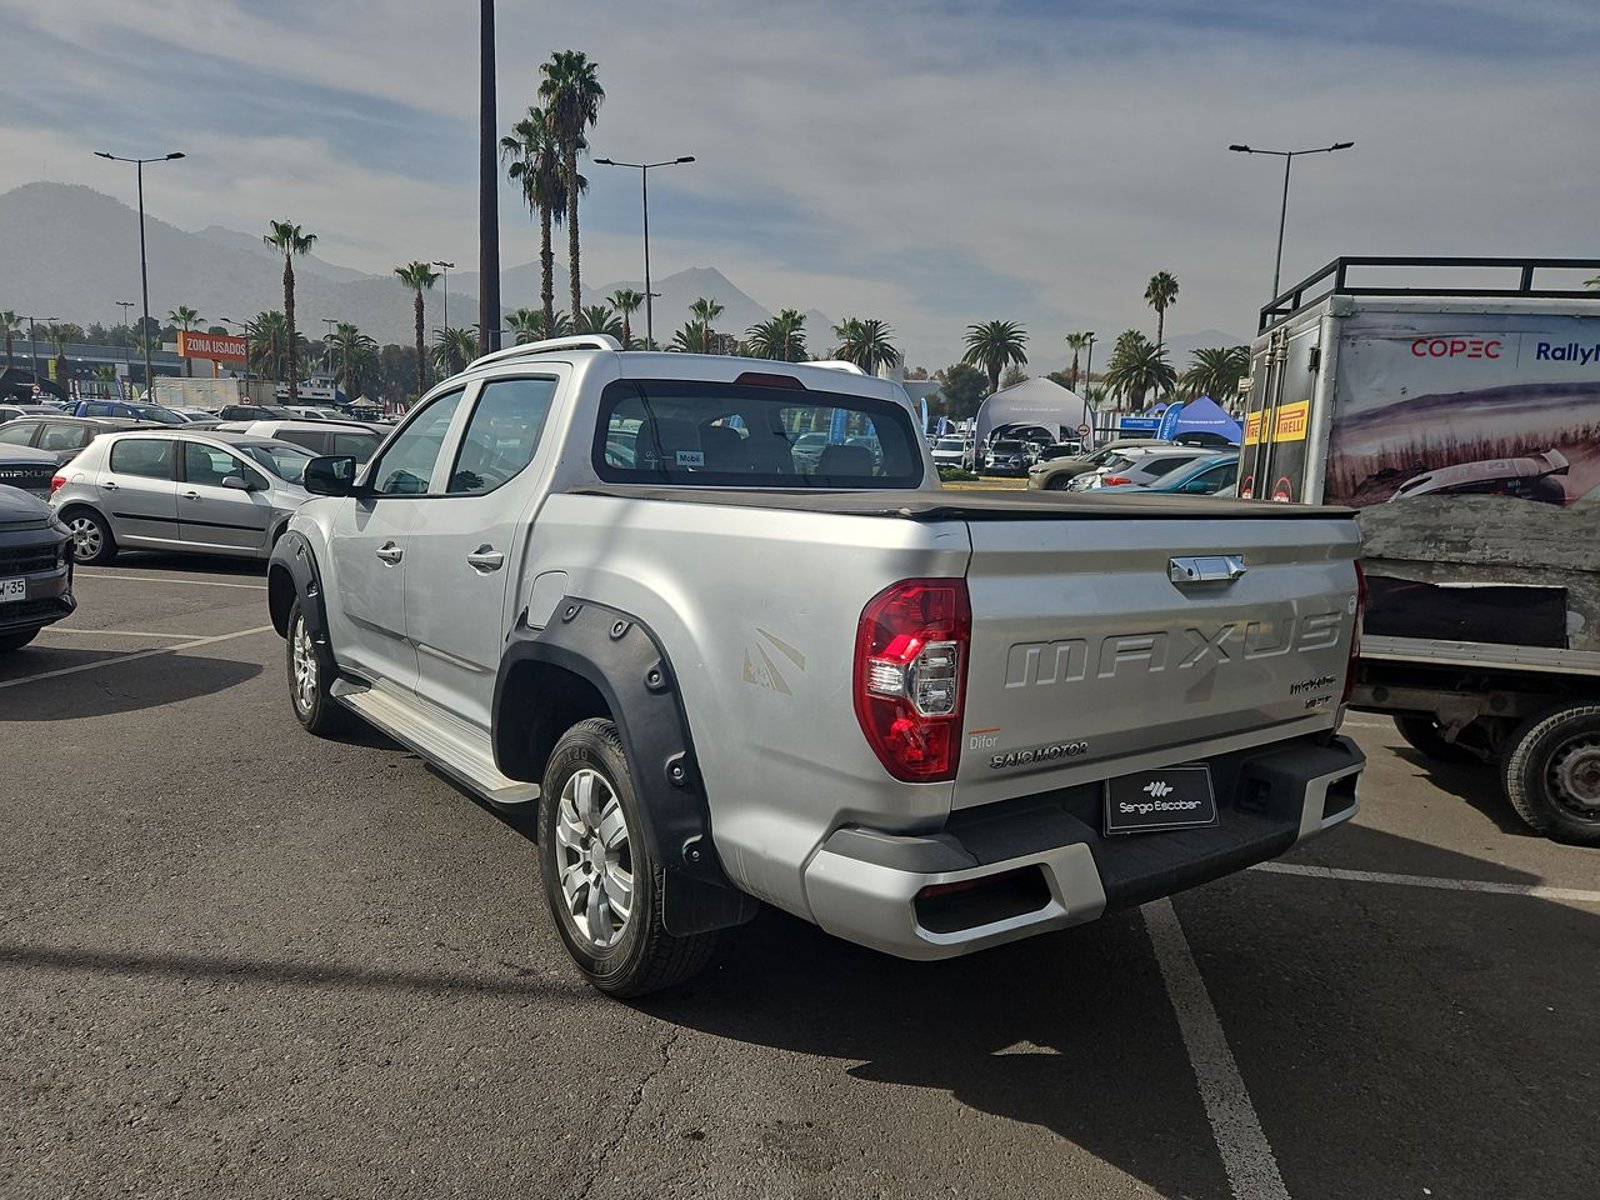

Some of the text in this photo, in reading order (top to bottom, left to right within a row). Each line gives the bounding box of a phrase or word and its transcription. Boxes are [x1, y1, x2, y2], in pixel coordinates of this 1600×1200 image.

[187, 338, 246, 356] ZONA USADOS
[1411, 338, 1502, 359] COPEC
[1005, 611, 1343, 689] MAXUS
[969, 735, 999, 750] Difor
[990, 750, 1034, 769] SAIC
[1154, 799, 1202, 811] Escobar
